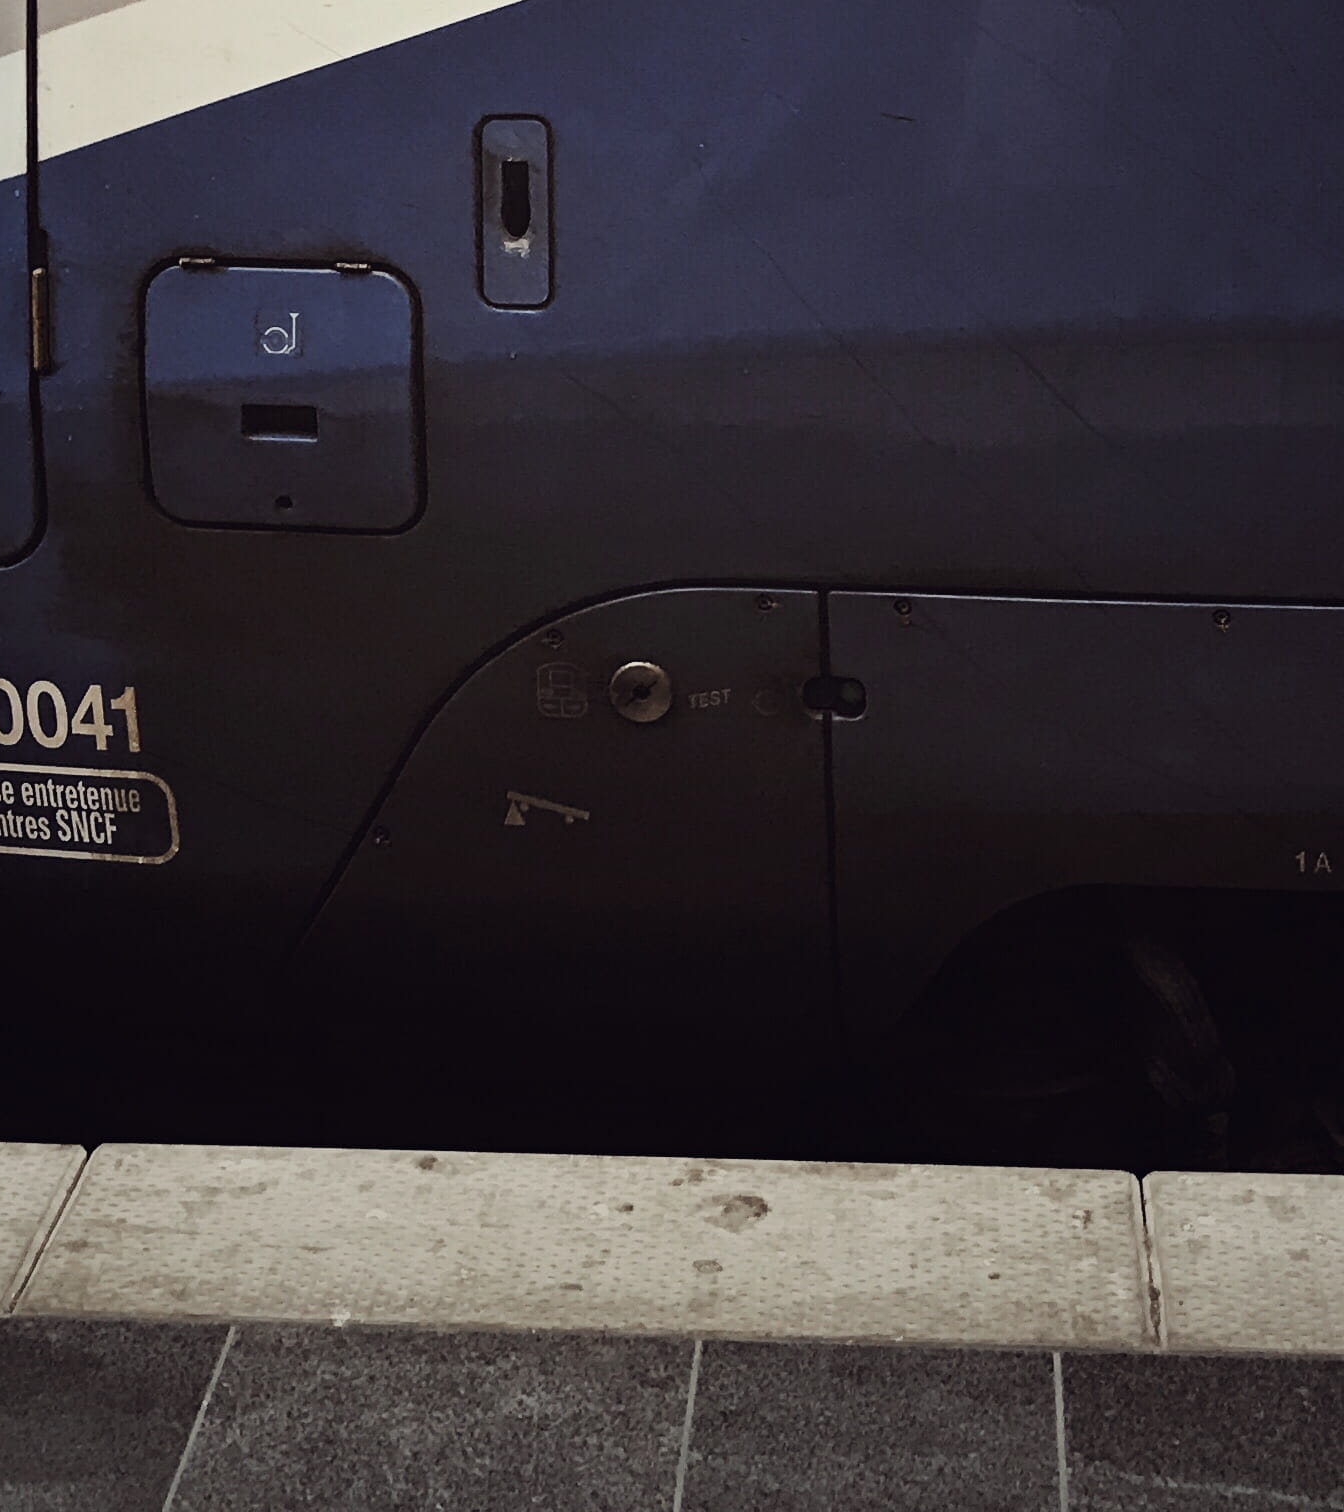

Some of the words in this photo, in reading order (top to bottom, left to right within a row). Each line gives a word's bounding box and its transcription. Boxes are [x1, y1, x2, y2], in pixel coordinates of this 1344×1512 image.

[687, 688, 732, 710] TEST
[20, 777, 142, 813] entretenue
[55, 810, 118, 845] SNCF
